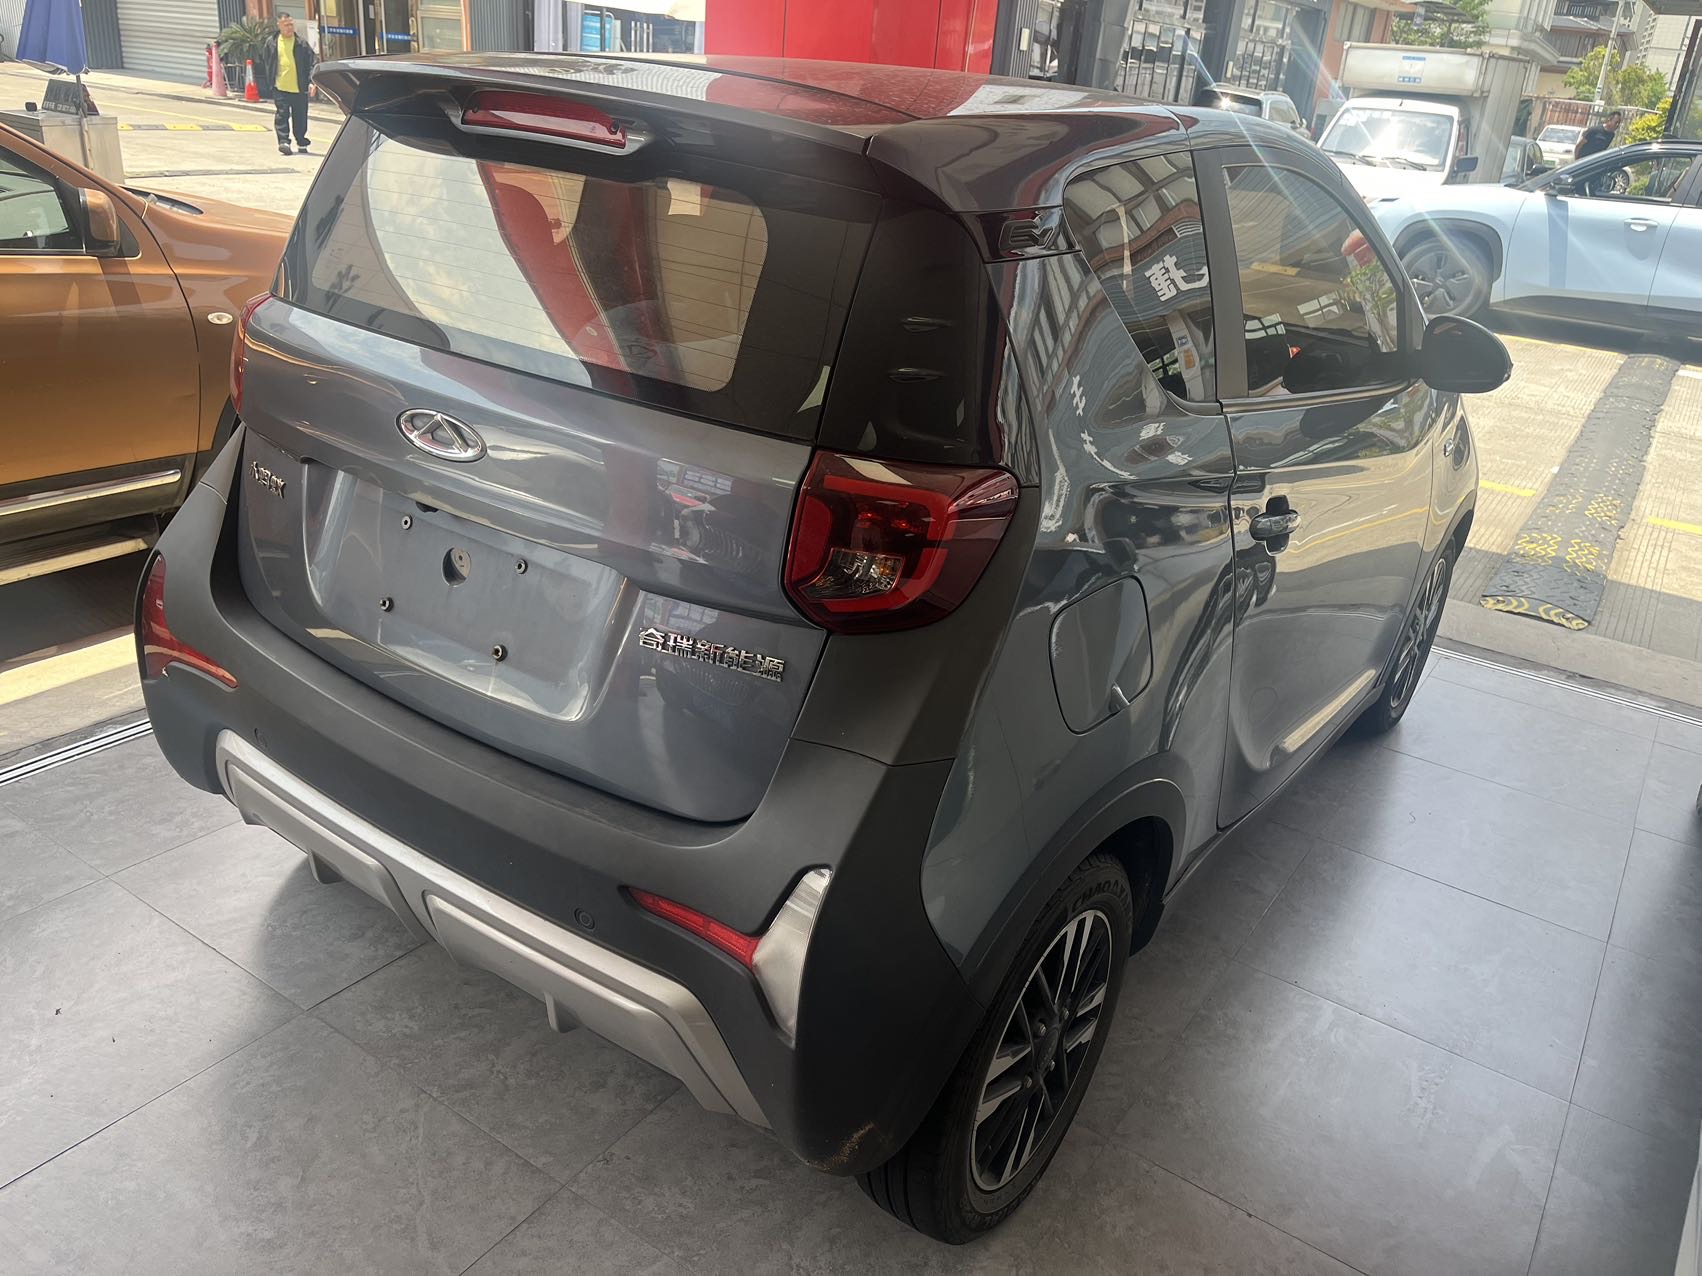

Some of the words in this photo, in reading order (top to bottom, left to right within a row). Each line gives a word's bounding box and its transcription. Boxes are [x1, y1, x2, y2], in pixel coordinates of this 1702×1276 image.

[638, 627, 785, 682] 奇瑞新能源
